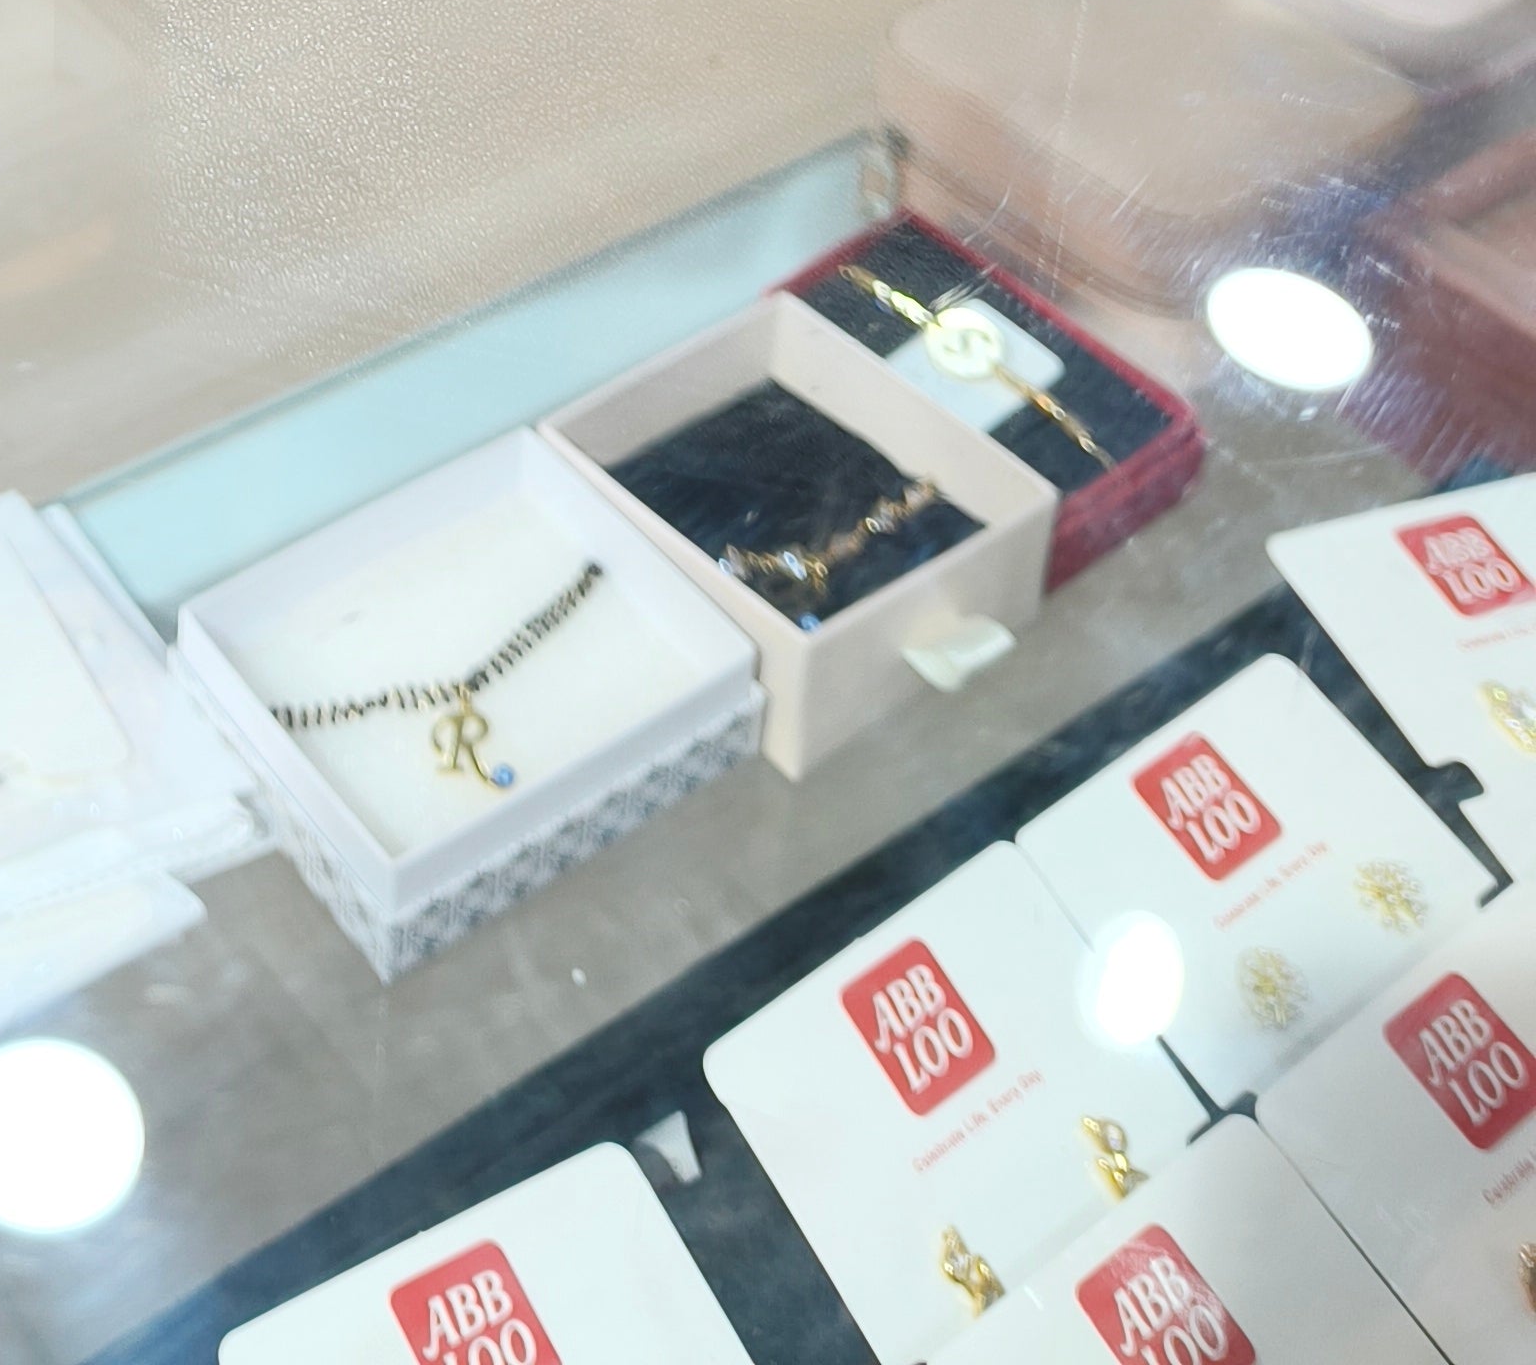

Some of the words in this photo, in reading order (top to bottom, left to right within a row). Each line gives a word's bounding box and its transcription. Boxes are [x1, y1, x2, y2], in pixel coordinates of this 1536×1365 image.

[1161, 754, 1232, 831] ABB
[872, 964, 946, 1053] ABB
[1419, 999, 1493, 1087] ABB
[422, 1269, 513, 1361] ABB
[1114, 1255, 1191, 1357] ABB
